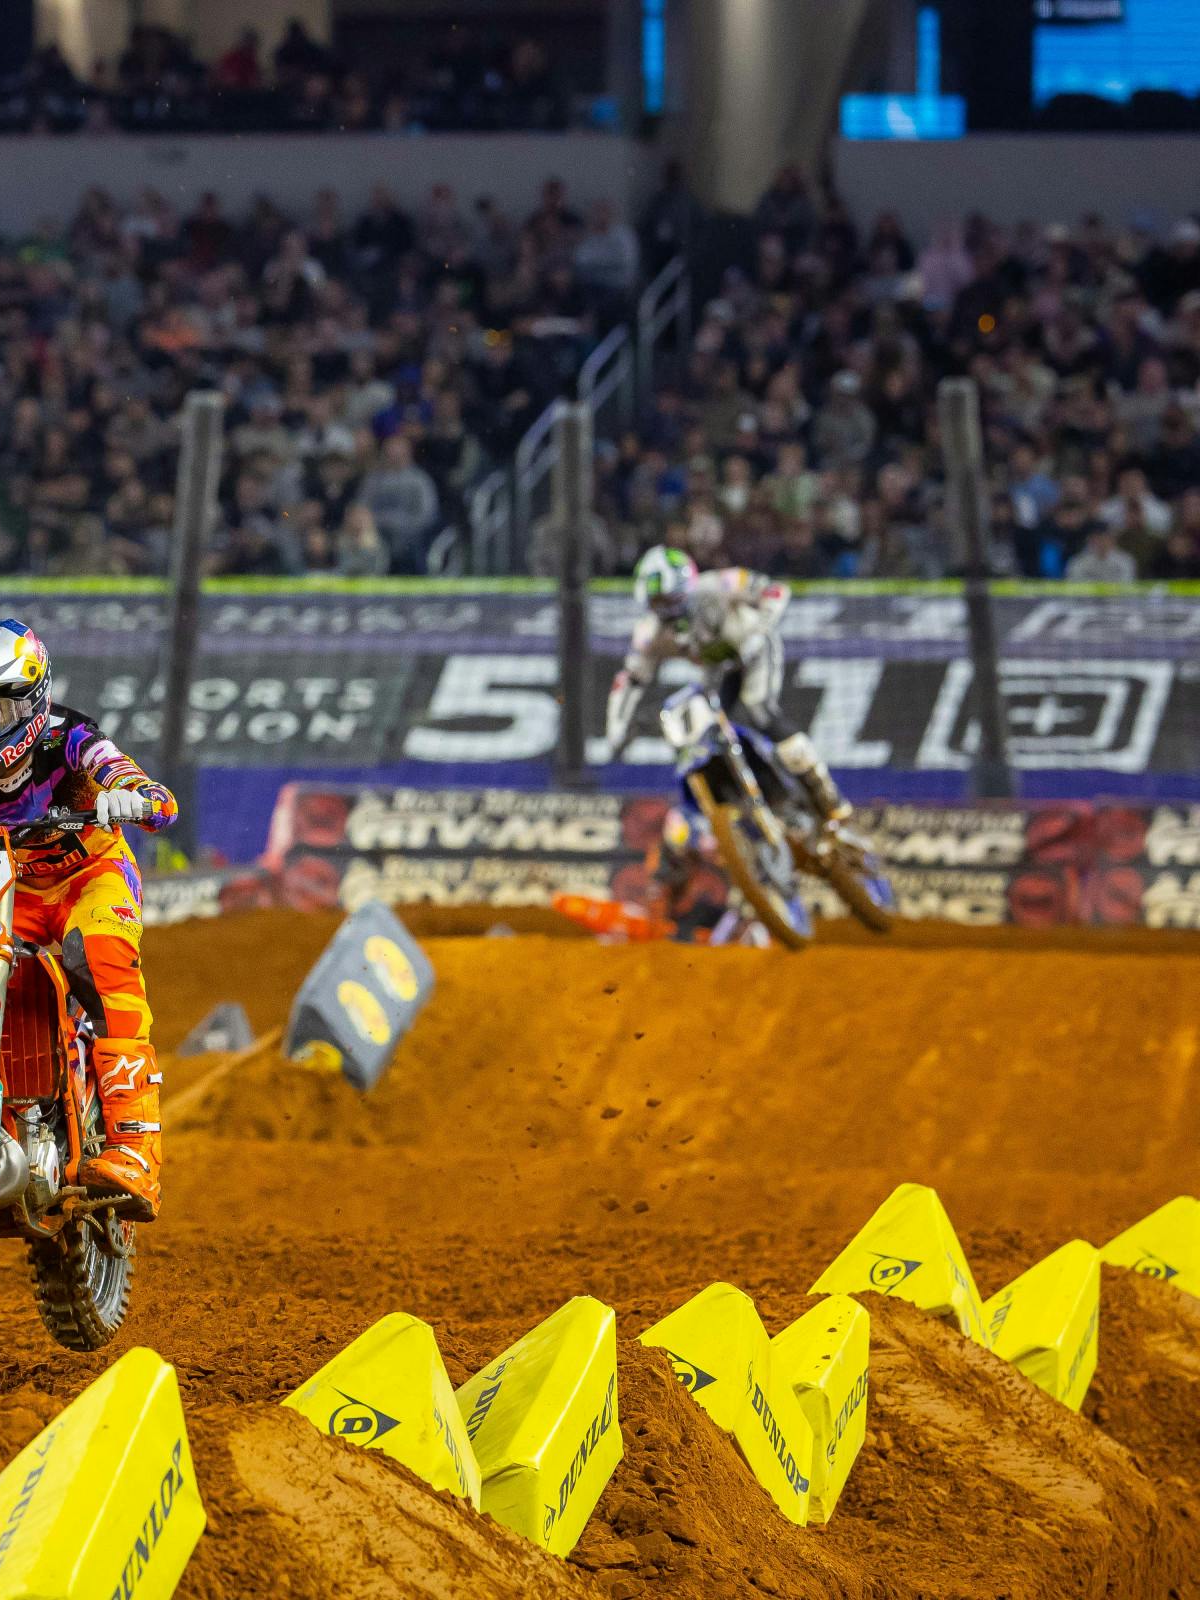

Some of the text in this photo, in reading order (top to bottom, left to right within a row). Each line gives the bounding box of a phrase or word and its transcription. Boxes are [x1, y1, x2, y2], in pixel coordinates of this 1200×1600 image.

[340, 1417, 372, 1433] D
[558, 1372, 615, 1520] DUNLOP
[751, 1382, 810, 1496] DUNLOP
